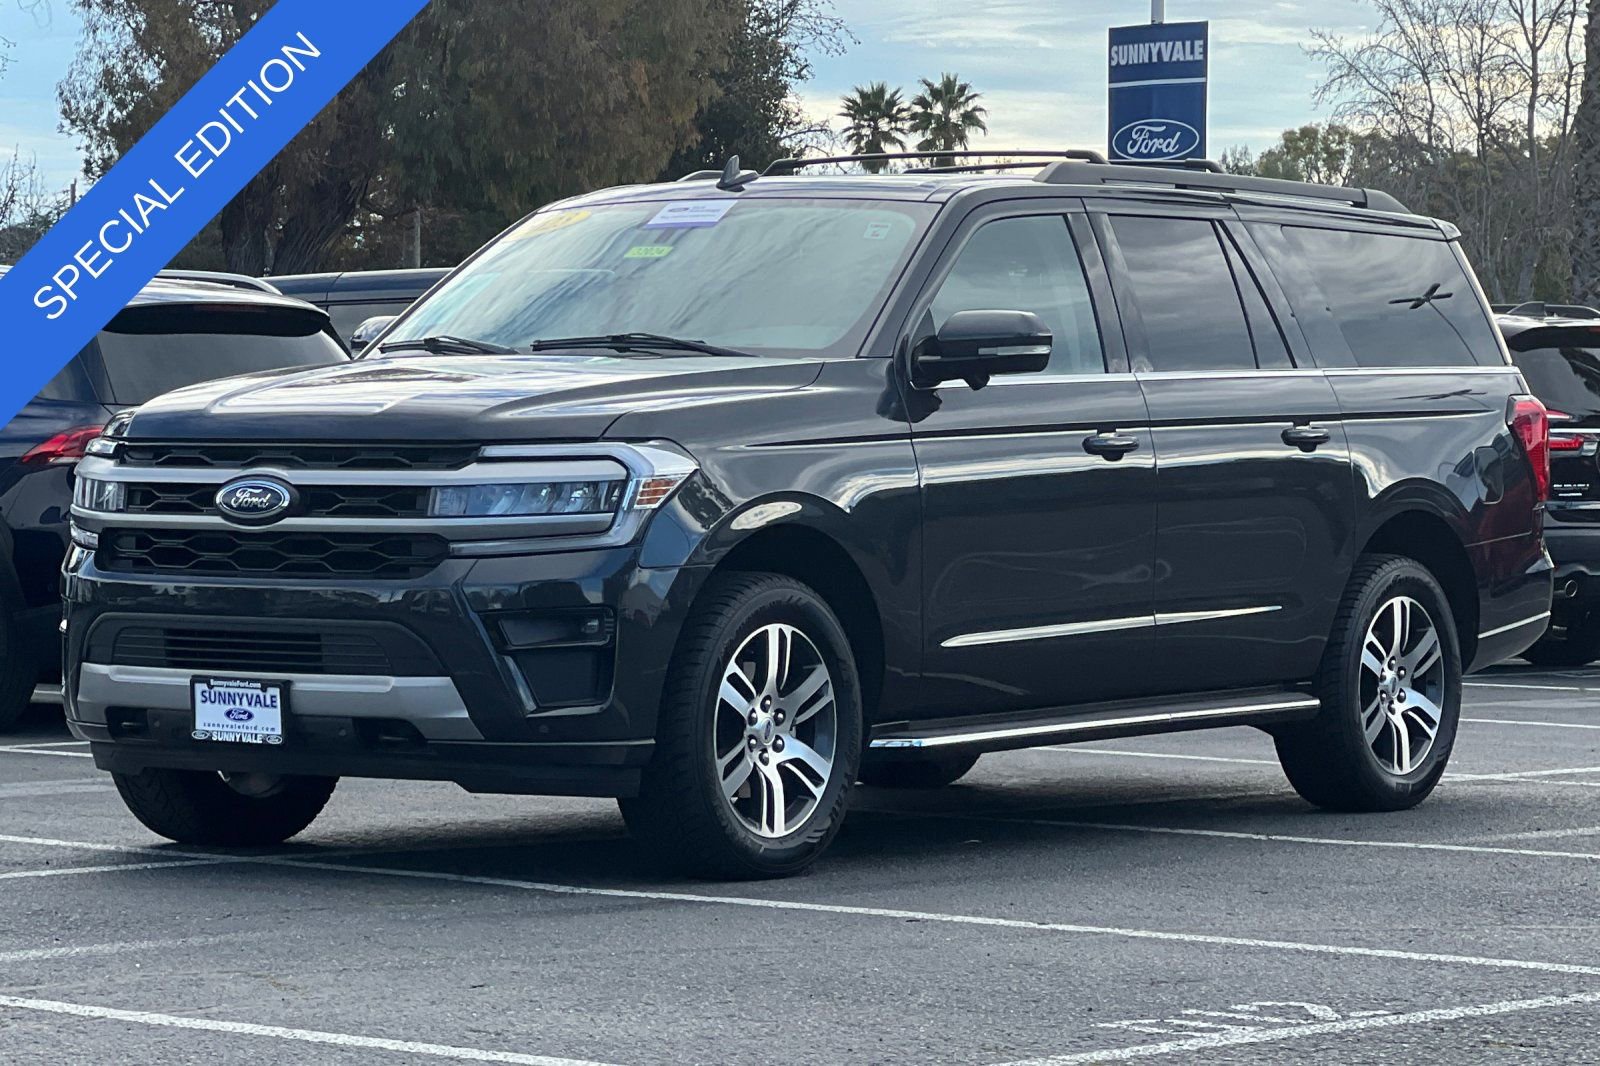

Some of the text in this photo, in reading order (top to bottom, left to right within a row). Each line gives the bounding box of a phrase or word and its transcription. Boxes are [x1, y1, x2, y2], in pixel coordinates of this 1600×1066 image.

[1110, 39, 1204, 67] SUNNYVALE
[1127, 125, 1182, 155] Ford
[231, 487, 271, 508] Ford
[201, 690, 277, 708] SUNNYVALE
[229, 709, 249, 720] Ford
[211, 731, 263, 744] SUNNYVALE
